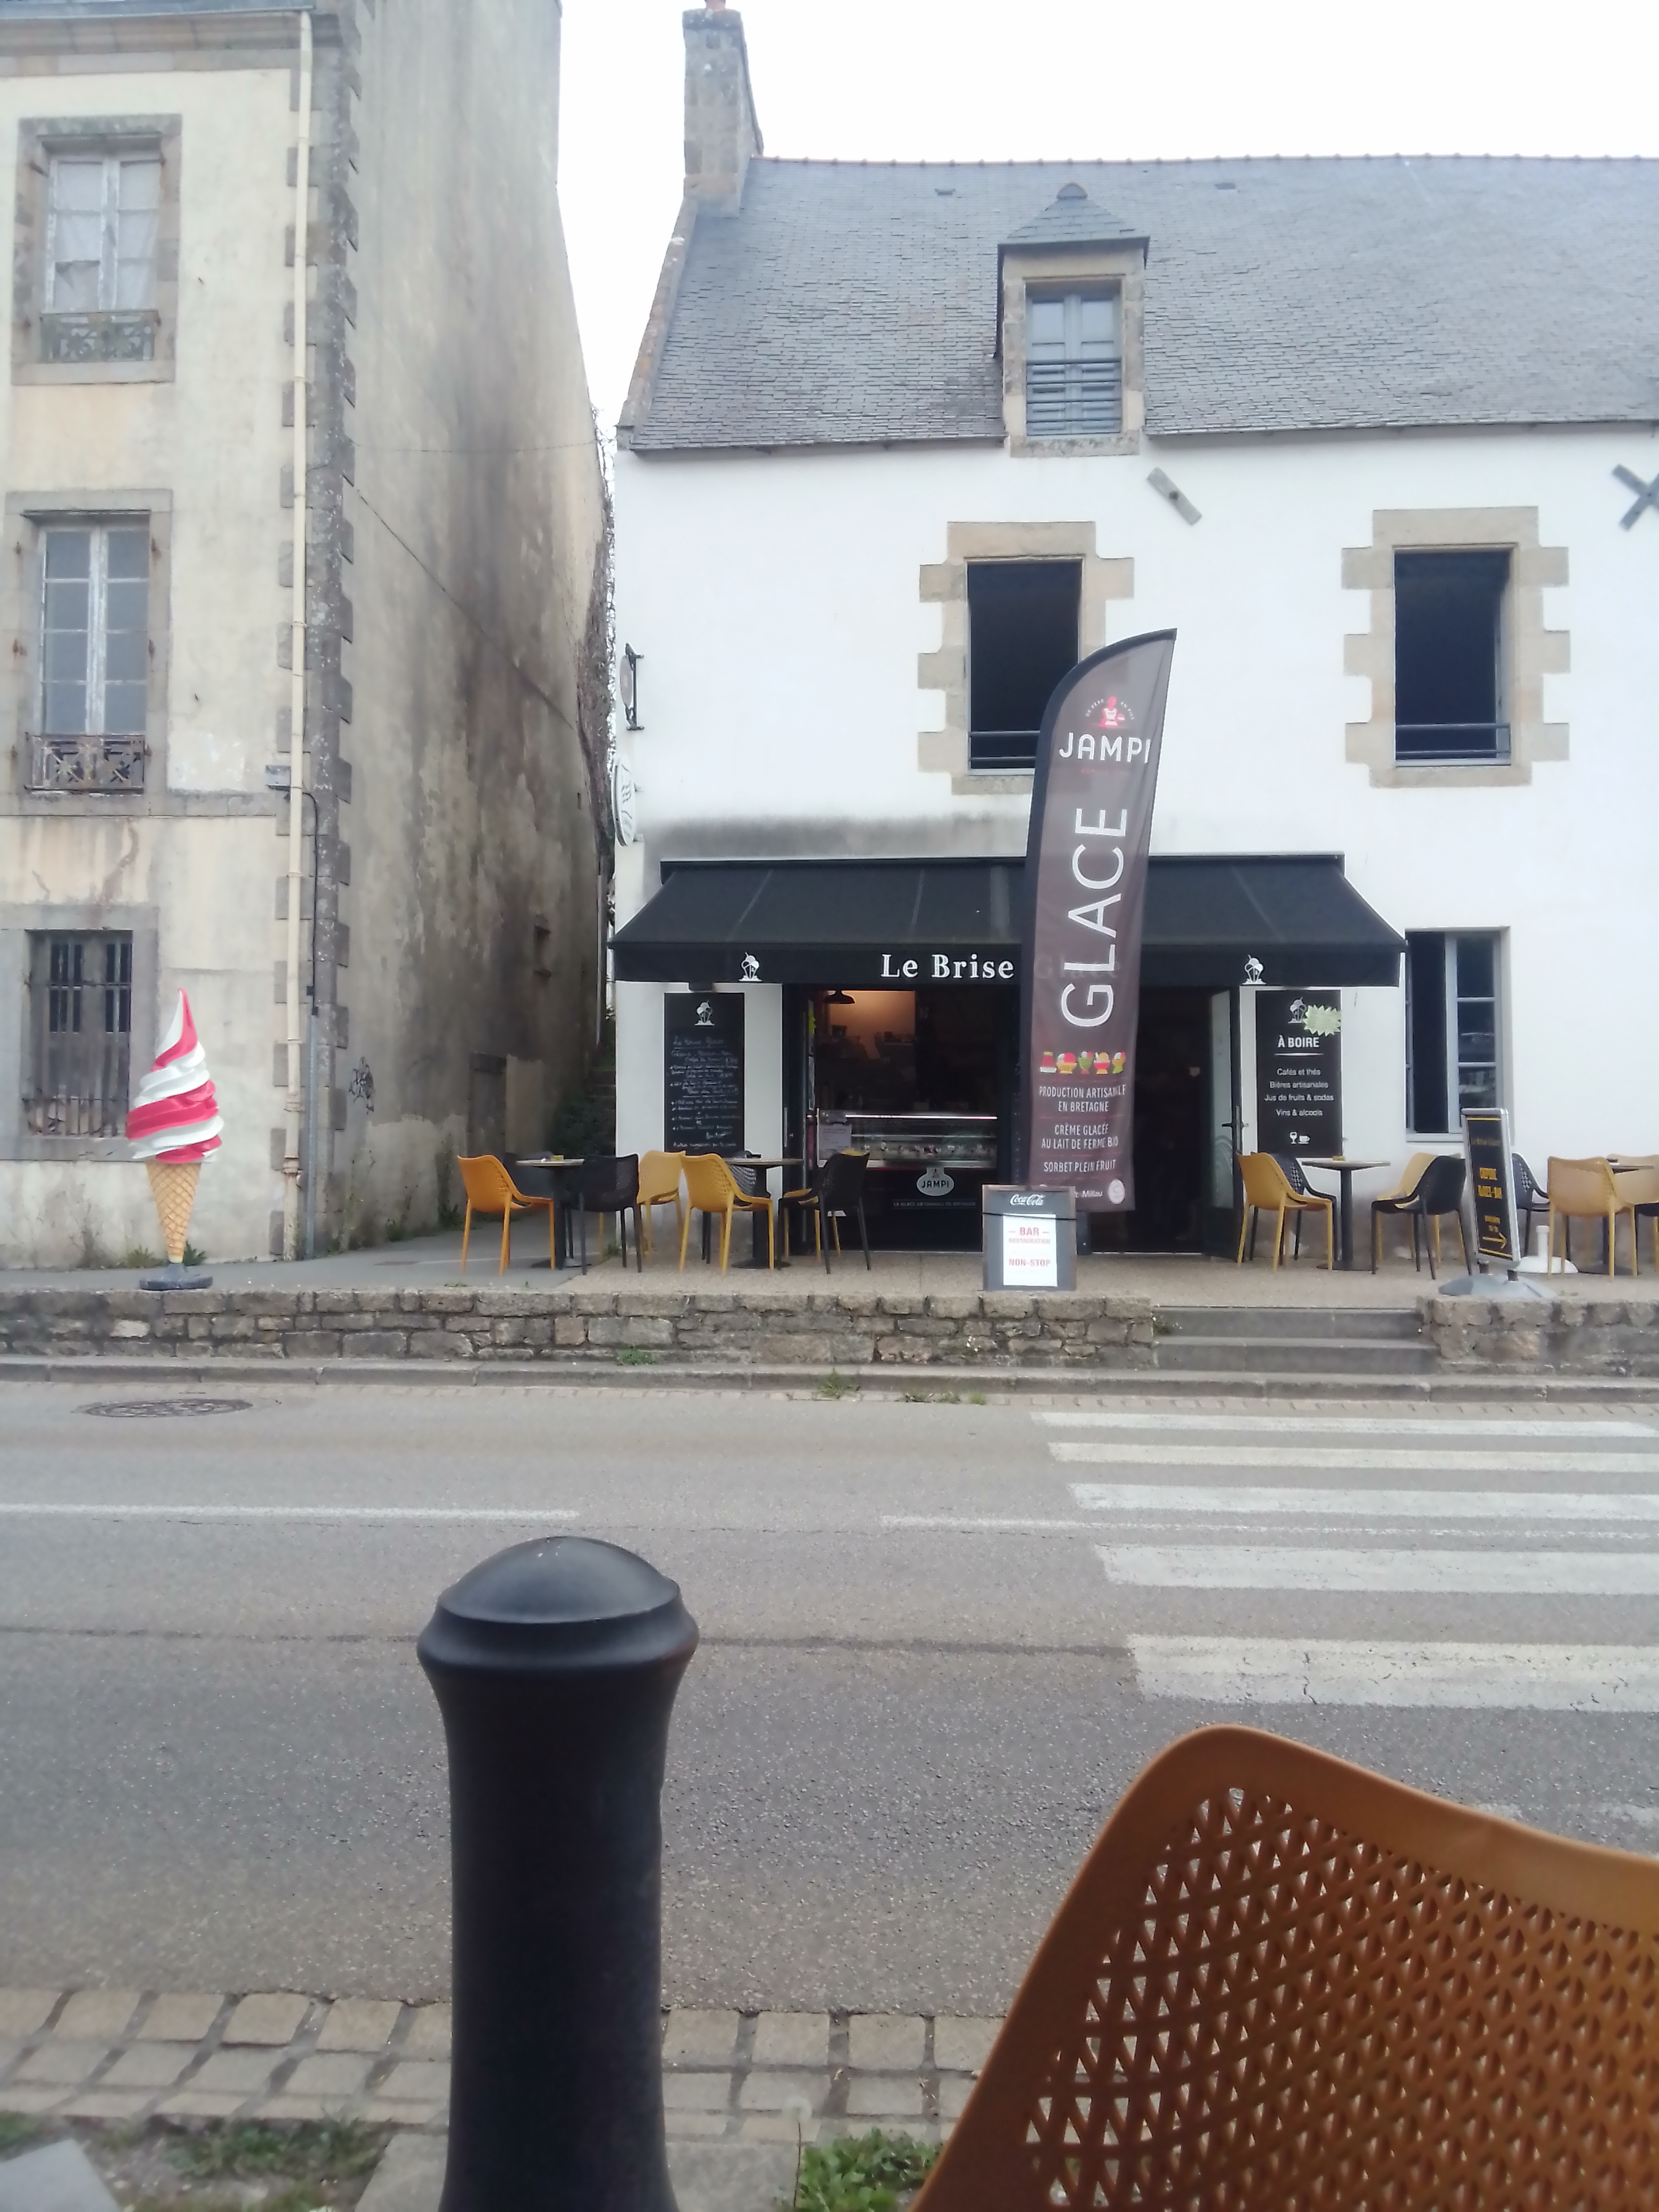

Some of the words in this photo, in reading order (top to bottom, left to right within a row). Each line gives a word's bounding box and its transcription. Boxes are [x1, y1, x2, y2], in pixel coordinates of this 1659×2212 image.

[1059, 732, 1151, 764] JAMPI
[1061, 809, 1127, 1027] GLACE
[881, 954, 918, 977] Le
[932, 954, 1014, 978] Brise
[1278, 1035, 1285, 1048] À
[1288, 1037, 1319, 1048] BOIRE
[1040, 1086, 1084, 1097] PRODUCTION
[1058, 1101, 1067, 1112] EN
[1070, 1101, 1109, 1112] BRETAGNE
[1055, 1123, 1080, 1135] CRÈME
[1083, 1123, 1109, 1135] GLACÉE
[1042, 1138, 1051, 1149] AU
[1053, 1138, 1069, 1149] LAIT
[1071, 1138, 1081, 1150] DE
[1084, 1137, 1106, 1149] FERME
[1044, 1161, 1073, 1172] SORBET
[1075, 1161, 1095, 1172] PLEIN
[1096, 1159, 1116, 1171] FRUIT
[1019, 1227, 1039, 1236] BAR
[1008, 1258, 1051, 1267] NON-STOP
